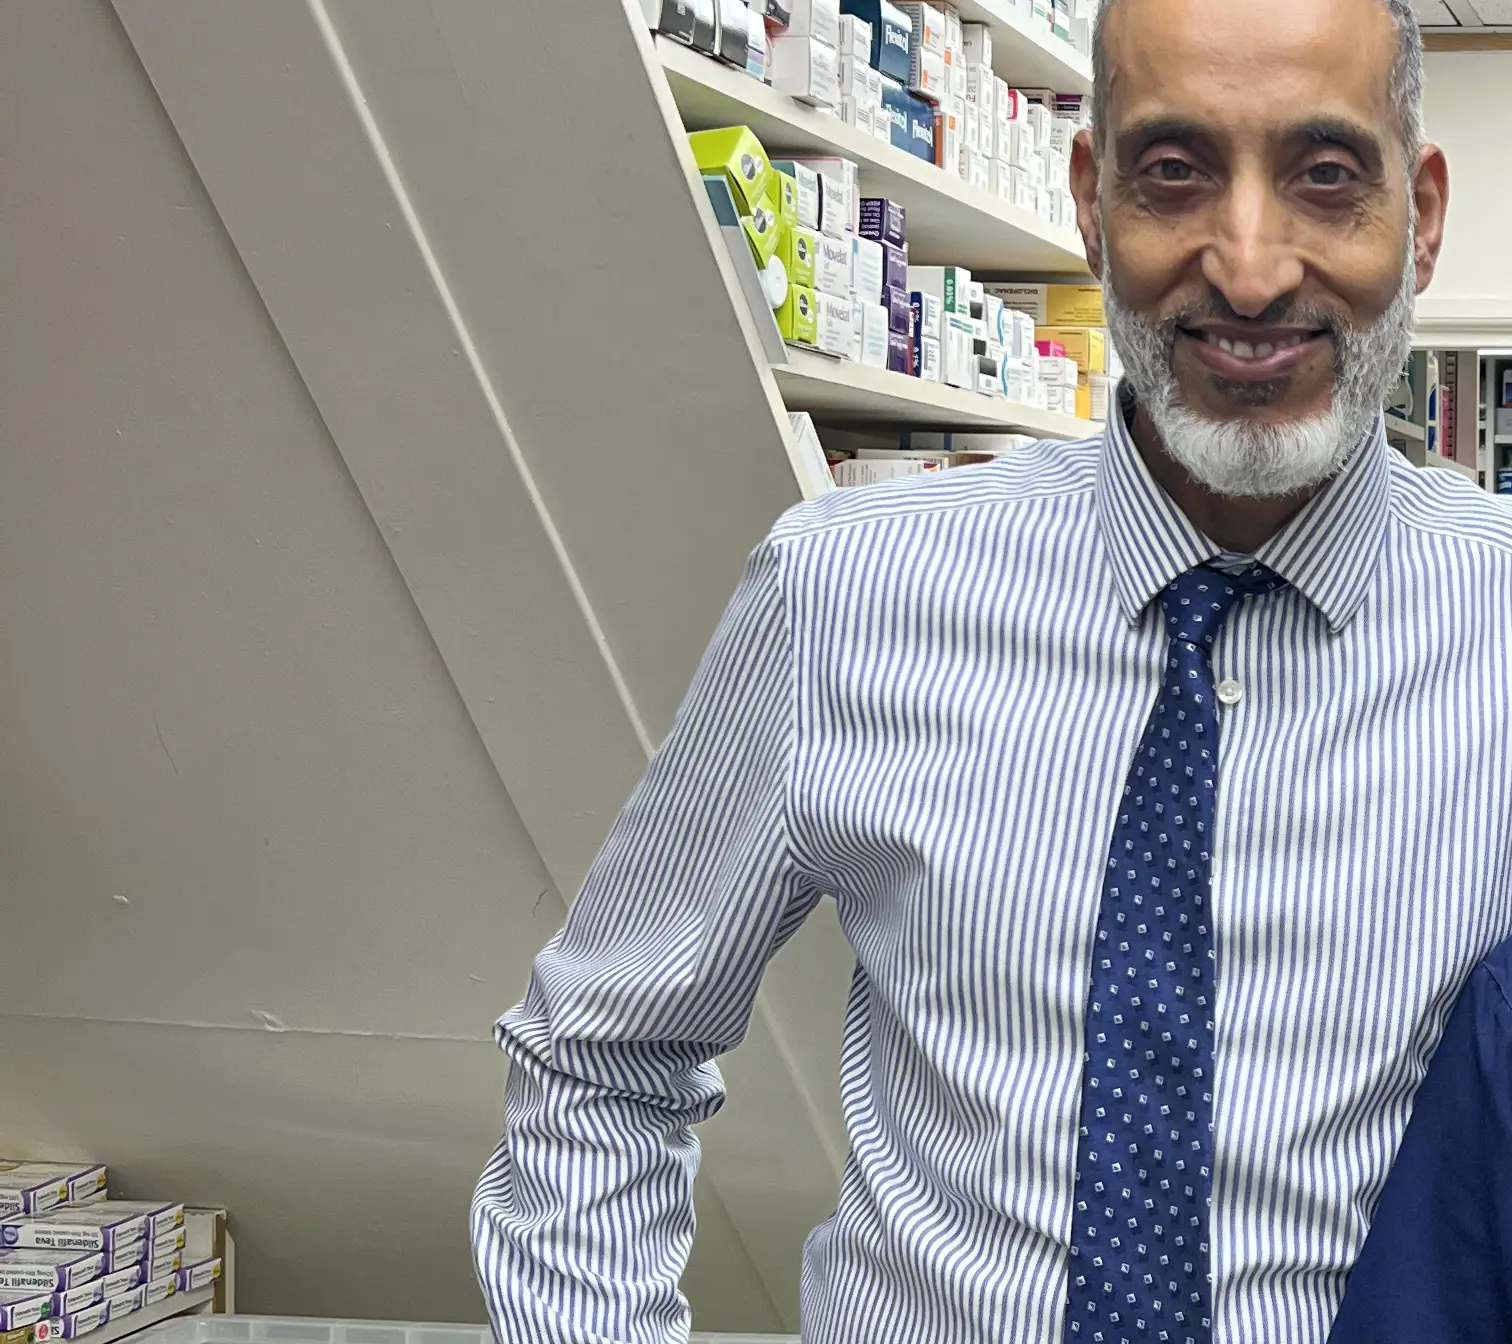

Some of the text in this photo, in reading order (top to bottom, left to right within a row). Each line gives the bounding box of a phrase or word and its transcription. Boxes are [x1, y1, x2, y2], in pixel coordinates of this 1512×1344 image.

[35, 1237, 99, 1249] Sildenafil Teva
[11, 1278, 54, 1288] Sildenafil
